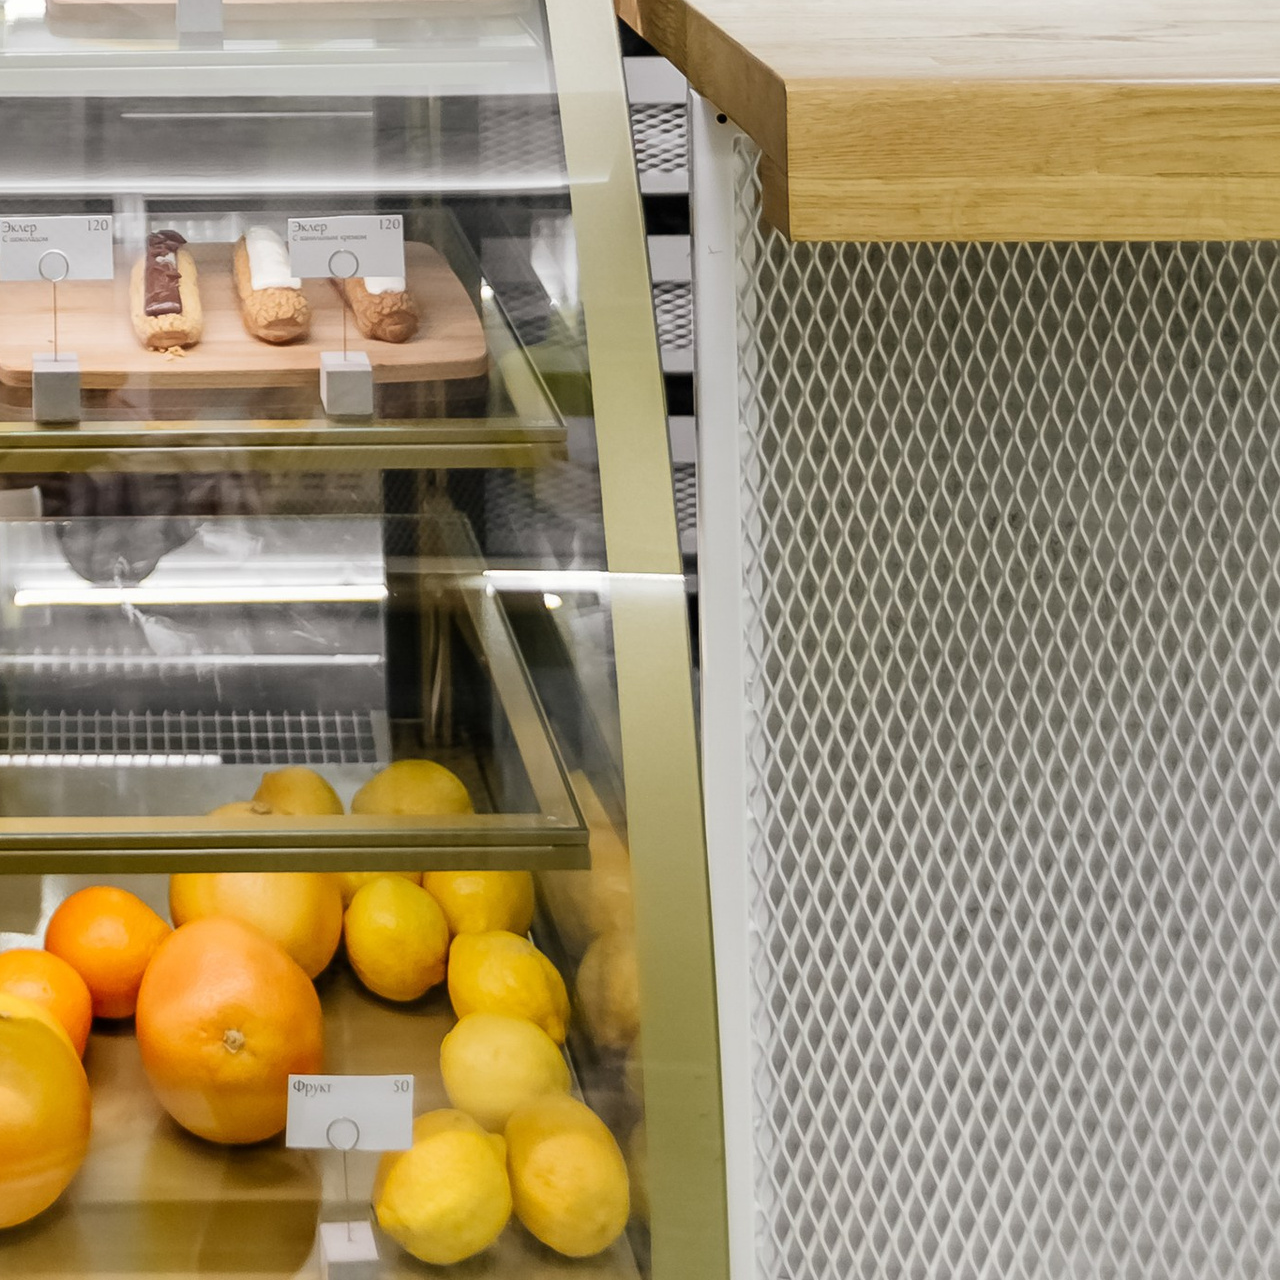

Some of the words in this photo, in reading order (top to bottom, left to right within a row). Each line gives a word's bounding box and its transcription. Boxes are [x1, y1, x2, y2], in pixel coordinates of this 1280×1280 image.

[2, 222, 36, 235] Эклер
[87, 220, 108, 231] 120
[292, 222, 327, 235] Эклер
[379, 219, 400, 230] 120
[293, 1079, 331, 1097] Фрукт
[393, 1080, 409, 1092] 50
